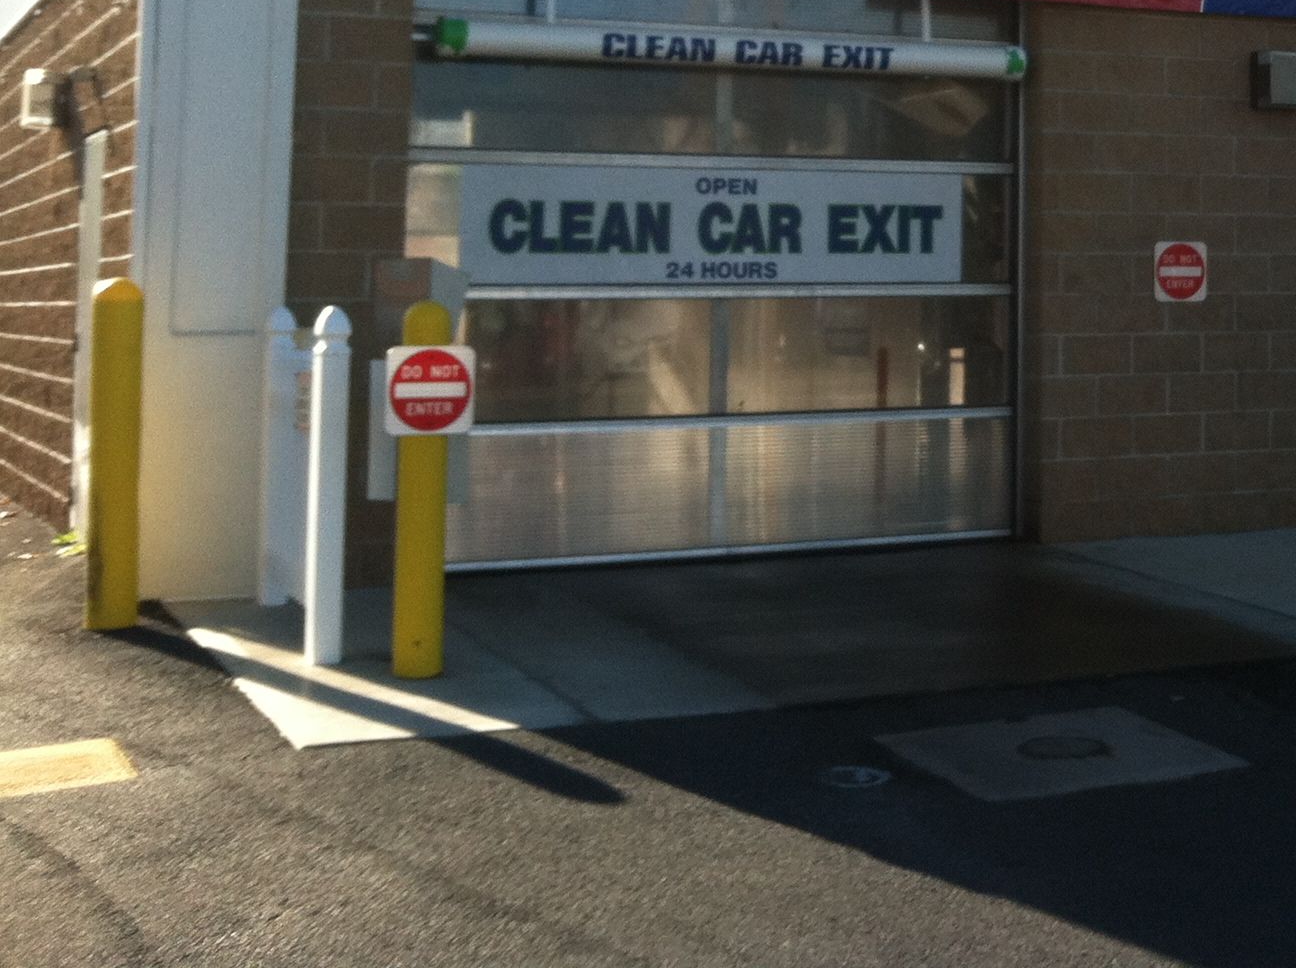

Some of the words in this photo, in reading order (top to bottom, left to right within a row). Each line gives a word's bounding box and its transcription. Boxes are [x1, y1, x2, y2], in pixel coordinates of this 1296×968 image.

[601, 32, 716, 63] CLEAN
[734, 40, 804, 66] CAR
[822, 43, 895, 70] EXIT
[695, 177, 757, 196] OPEN
[488, 198, 671, 255] CLEAN
[697, 203, 802, 255] CAR
[827, 205, 943, 255] EXIT
[1180, 253, 1197, 264] NOT
[665, 262, 694, 279] 24
[701, 261, 778, 279] HOURS
[1166, 279, 1194, 288] ENTER
[400, 365, 423, 379] DO
[430, 364, 460, 378] NOT
[405, 402, 453, 416] ENTER
